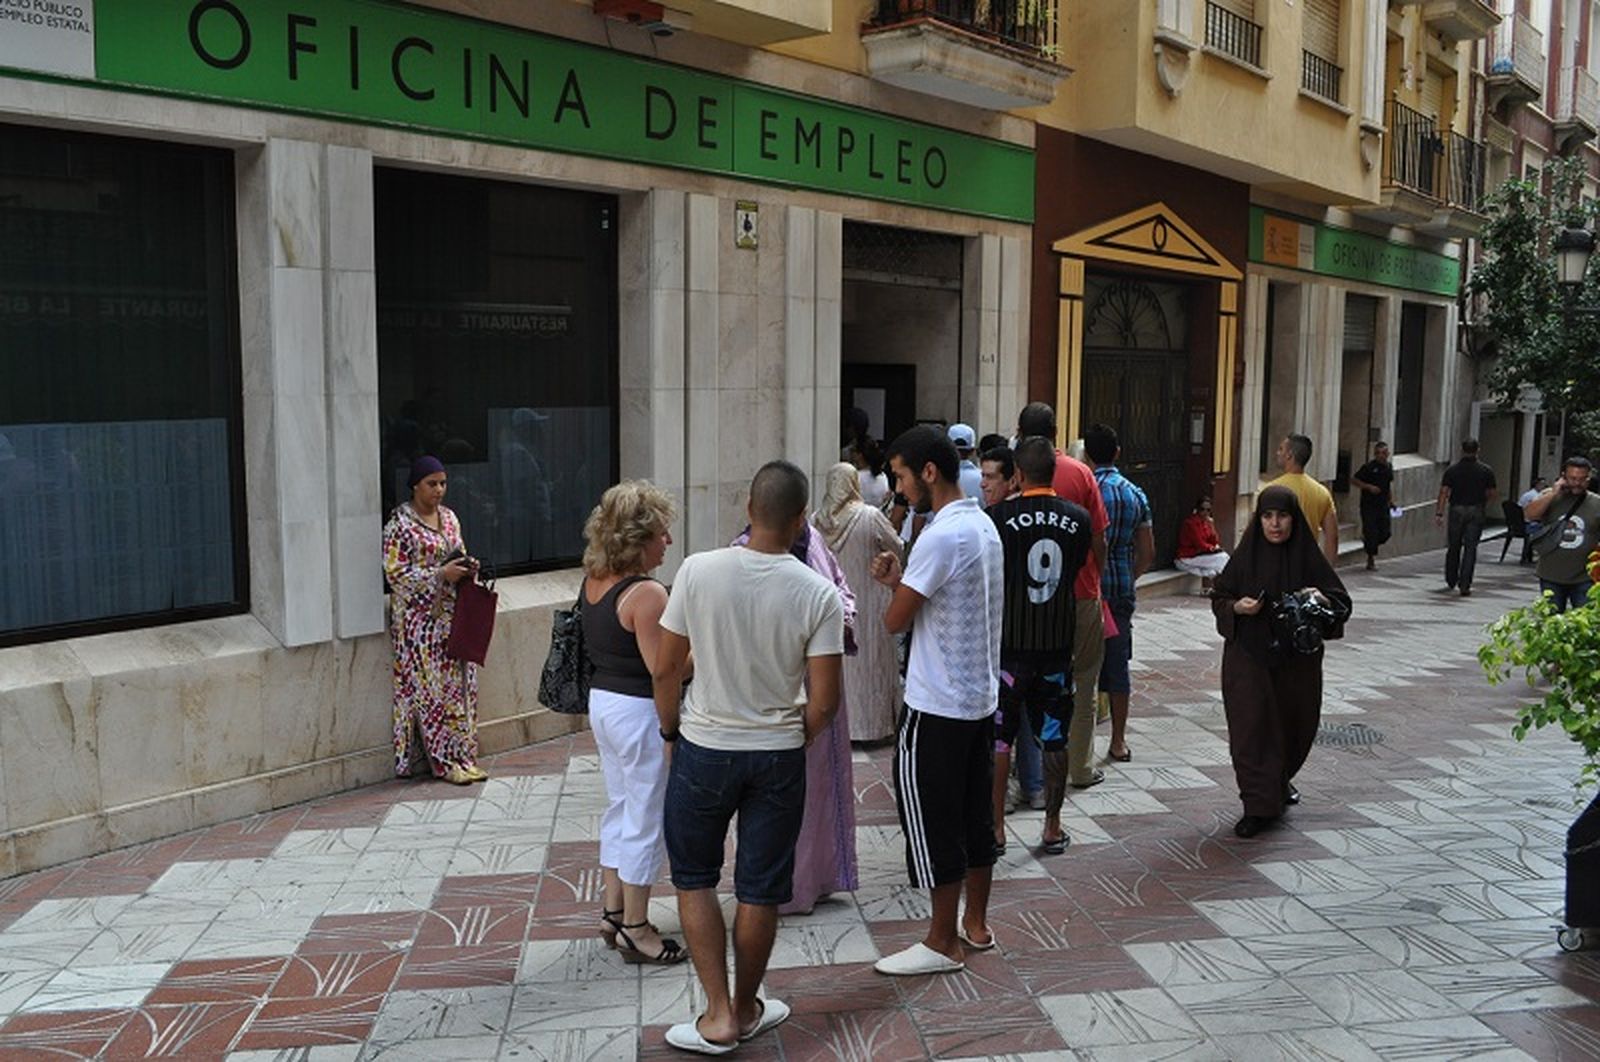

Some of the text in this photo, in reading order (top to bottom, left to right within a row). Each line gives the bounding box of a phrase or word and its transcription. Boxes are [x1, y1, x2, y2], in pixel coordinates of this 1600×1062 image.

[46, 15, 90, 33] ESTATAL
[187, 0, 947, 189] OFICINA DE EMPLEO
[1005, 511, 1079, 534] TORRES
[1027, 538, 1063, 605] 9
